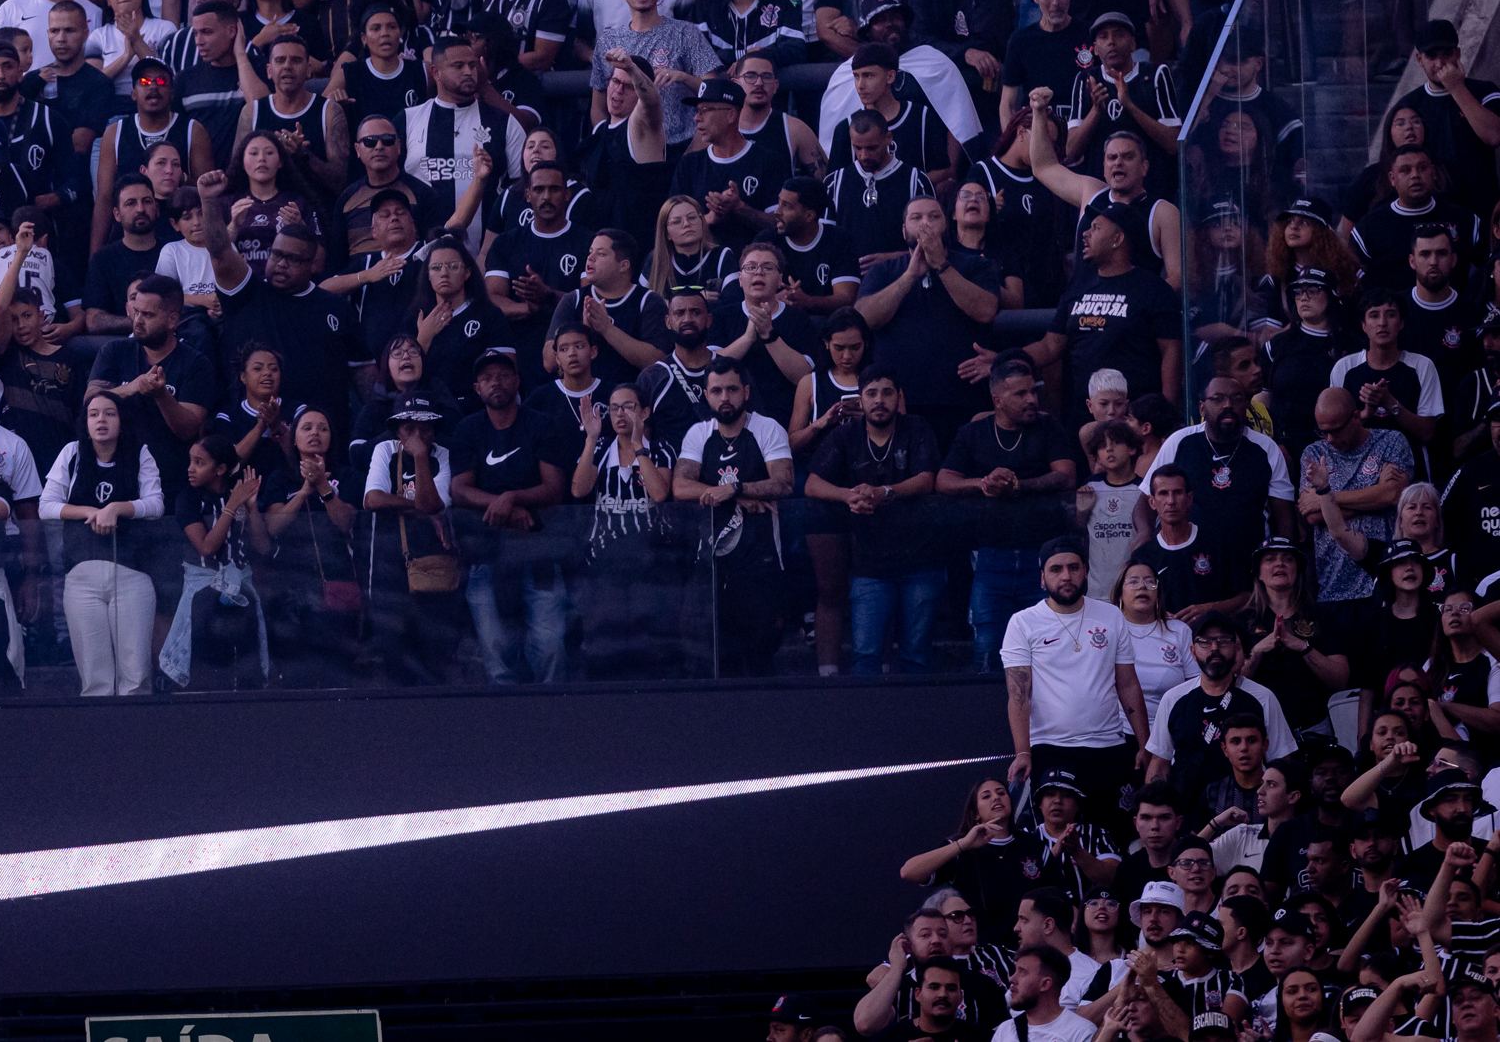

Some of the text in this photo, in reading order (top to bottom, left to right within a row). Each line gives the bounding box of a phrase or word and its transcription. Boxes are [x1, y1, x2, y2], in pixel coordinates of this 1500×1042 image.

[418, 157, 474, 171] Esporte
[1092, 294, 1115, 303] ESTADO
[1116, 294, 1127, 302] DE
[671, 362, 700, 405] NIKE
[595, 492, 655, 515] Kalung
[1093, 522, 1133, 533] Esportes
[1094, 529, 1131, 539] da Sorte
